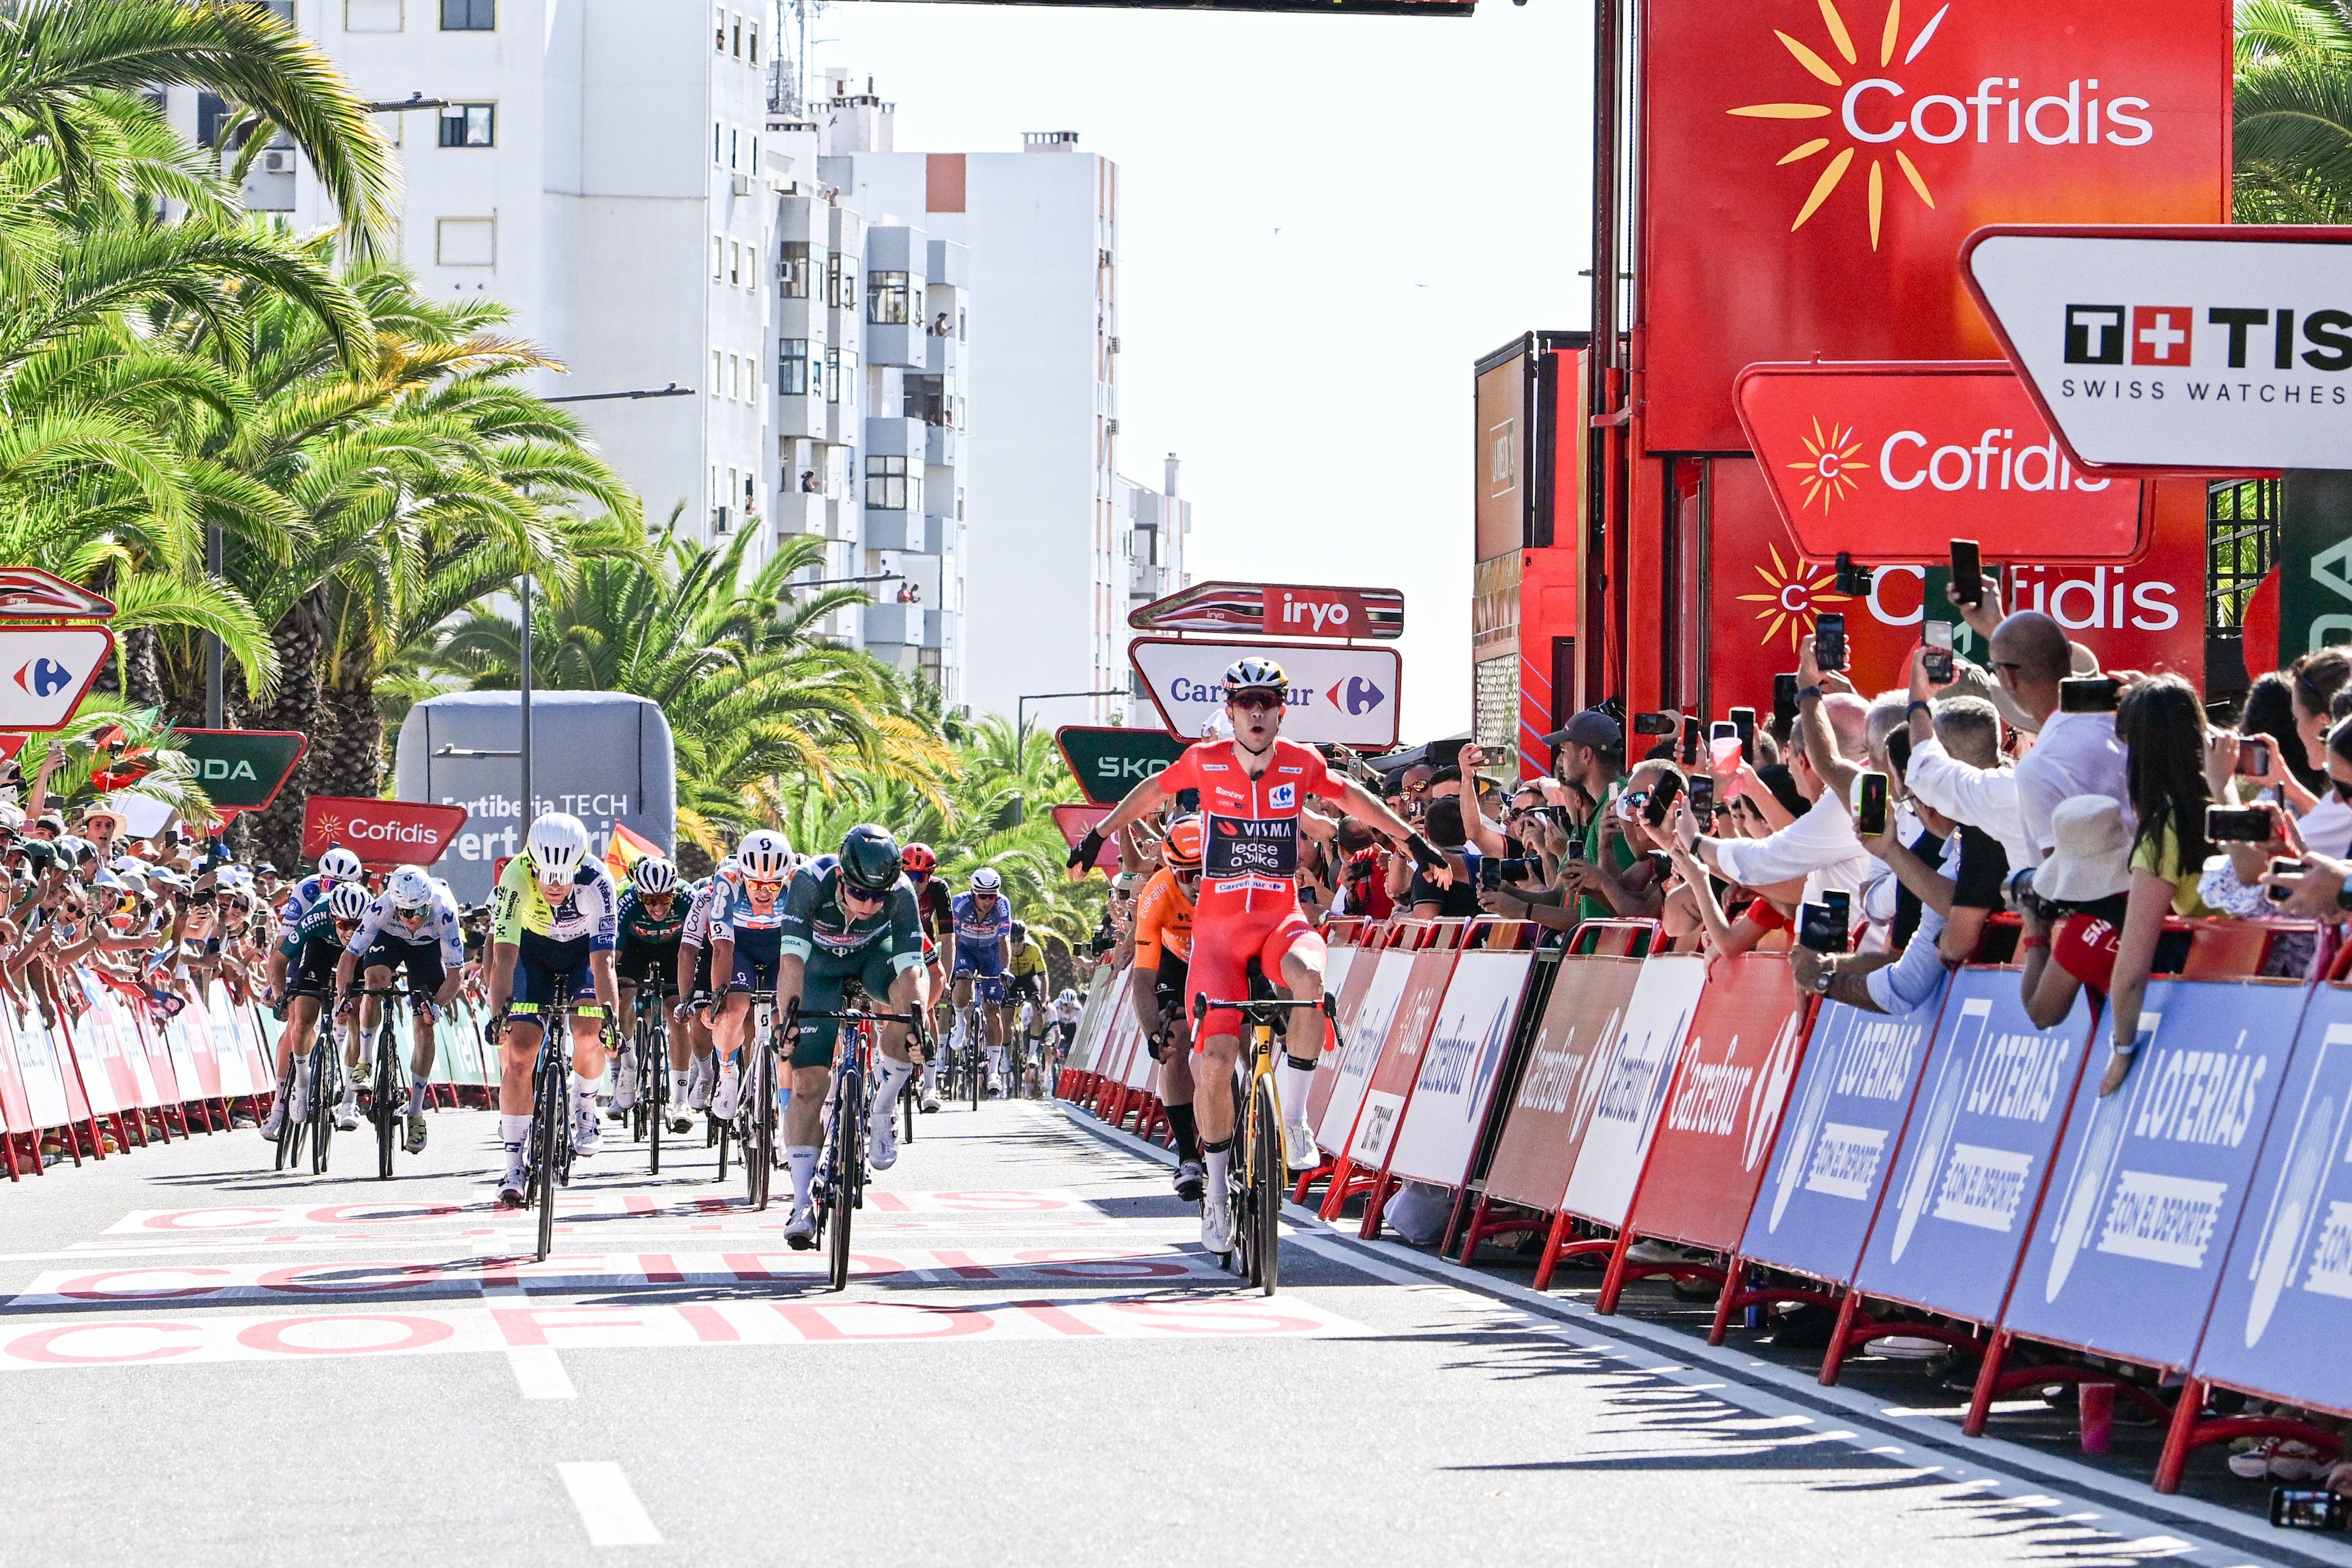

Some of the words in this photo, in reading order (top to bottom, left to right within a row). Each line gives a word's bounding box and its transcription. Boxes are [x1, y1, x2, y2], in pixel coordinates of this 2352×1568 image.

[1841, 76, 2153, 146] Cofidis
[2073, 311, 2119, 358] T
[2062, 380, 2164, 400] SWISS
[2187, 383, 2346, 404] WATCHES
[1880, 429, 2112, 492] Cofid
[1207, 610, 1225, 620] iryo
[1283, 593, 1349, 633] iryo
[1866, 565, 2179, 631] Cfidis
[1171, 677, 1313, 706] Carur
[187, 758, 257, 781] ODA
[1097, 757, 1171, 778] SKO
[442, 795, 554, 818] rtibeia
[560, 794, 627, 816] TECH
[1215, 786, 1245, 800] Santini
[348, 818, 438, 844] Cofidis
[1231, 841, 1278, 855] lease
[1242, 823, 1291, 837] VISMA
[505, 890, 518, 920] TECHNORD
[596, 880, 611, 914] Wallonie
[617, 892, 633, 914] ERN
[687, 893, 711, 932] Cofidis
[1140, 881, 1169, 920] euskaltel
[300, 911, 327, 929] KERN
[781, 914, 803, 924] antini
[783, 939, 801, 947] ODA
[800, 1025, 819, 1034] ntini
[1418, 1014, 1476, 1095] Carrefour
[1518, 1025, 1584, 1113] Carrefour
[1598, 1031, 1656, 1124] Carrefour
[1668, 1034, 1753, 1136] Carrefour
[1839, 1144, 1877, 1183] DEPORTE
[1946, 1162, 1973, 1203] CON
[1964, 1166, 1982, 1205] EL
[1976, 1168, 2021, 1213] DEPORTE
[2113, 1191, 2146, 1236] CON
[2137, 1195, 2158, 1238] EL
[2152, 1196, 2212, 1247] DEPORTE
[56, 1249, 1190, 1300] COFIDIS
[4, 1296, 1322, 1363] COFIDIS
